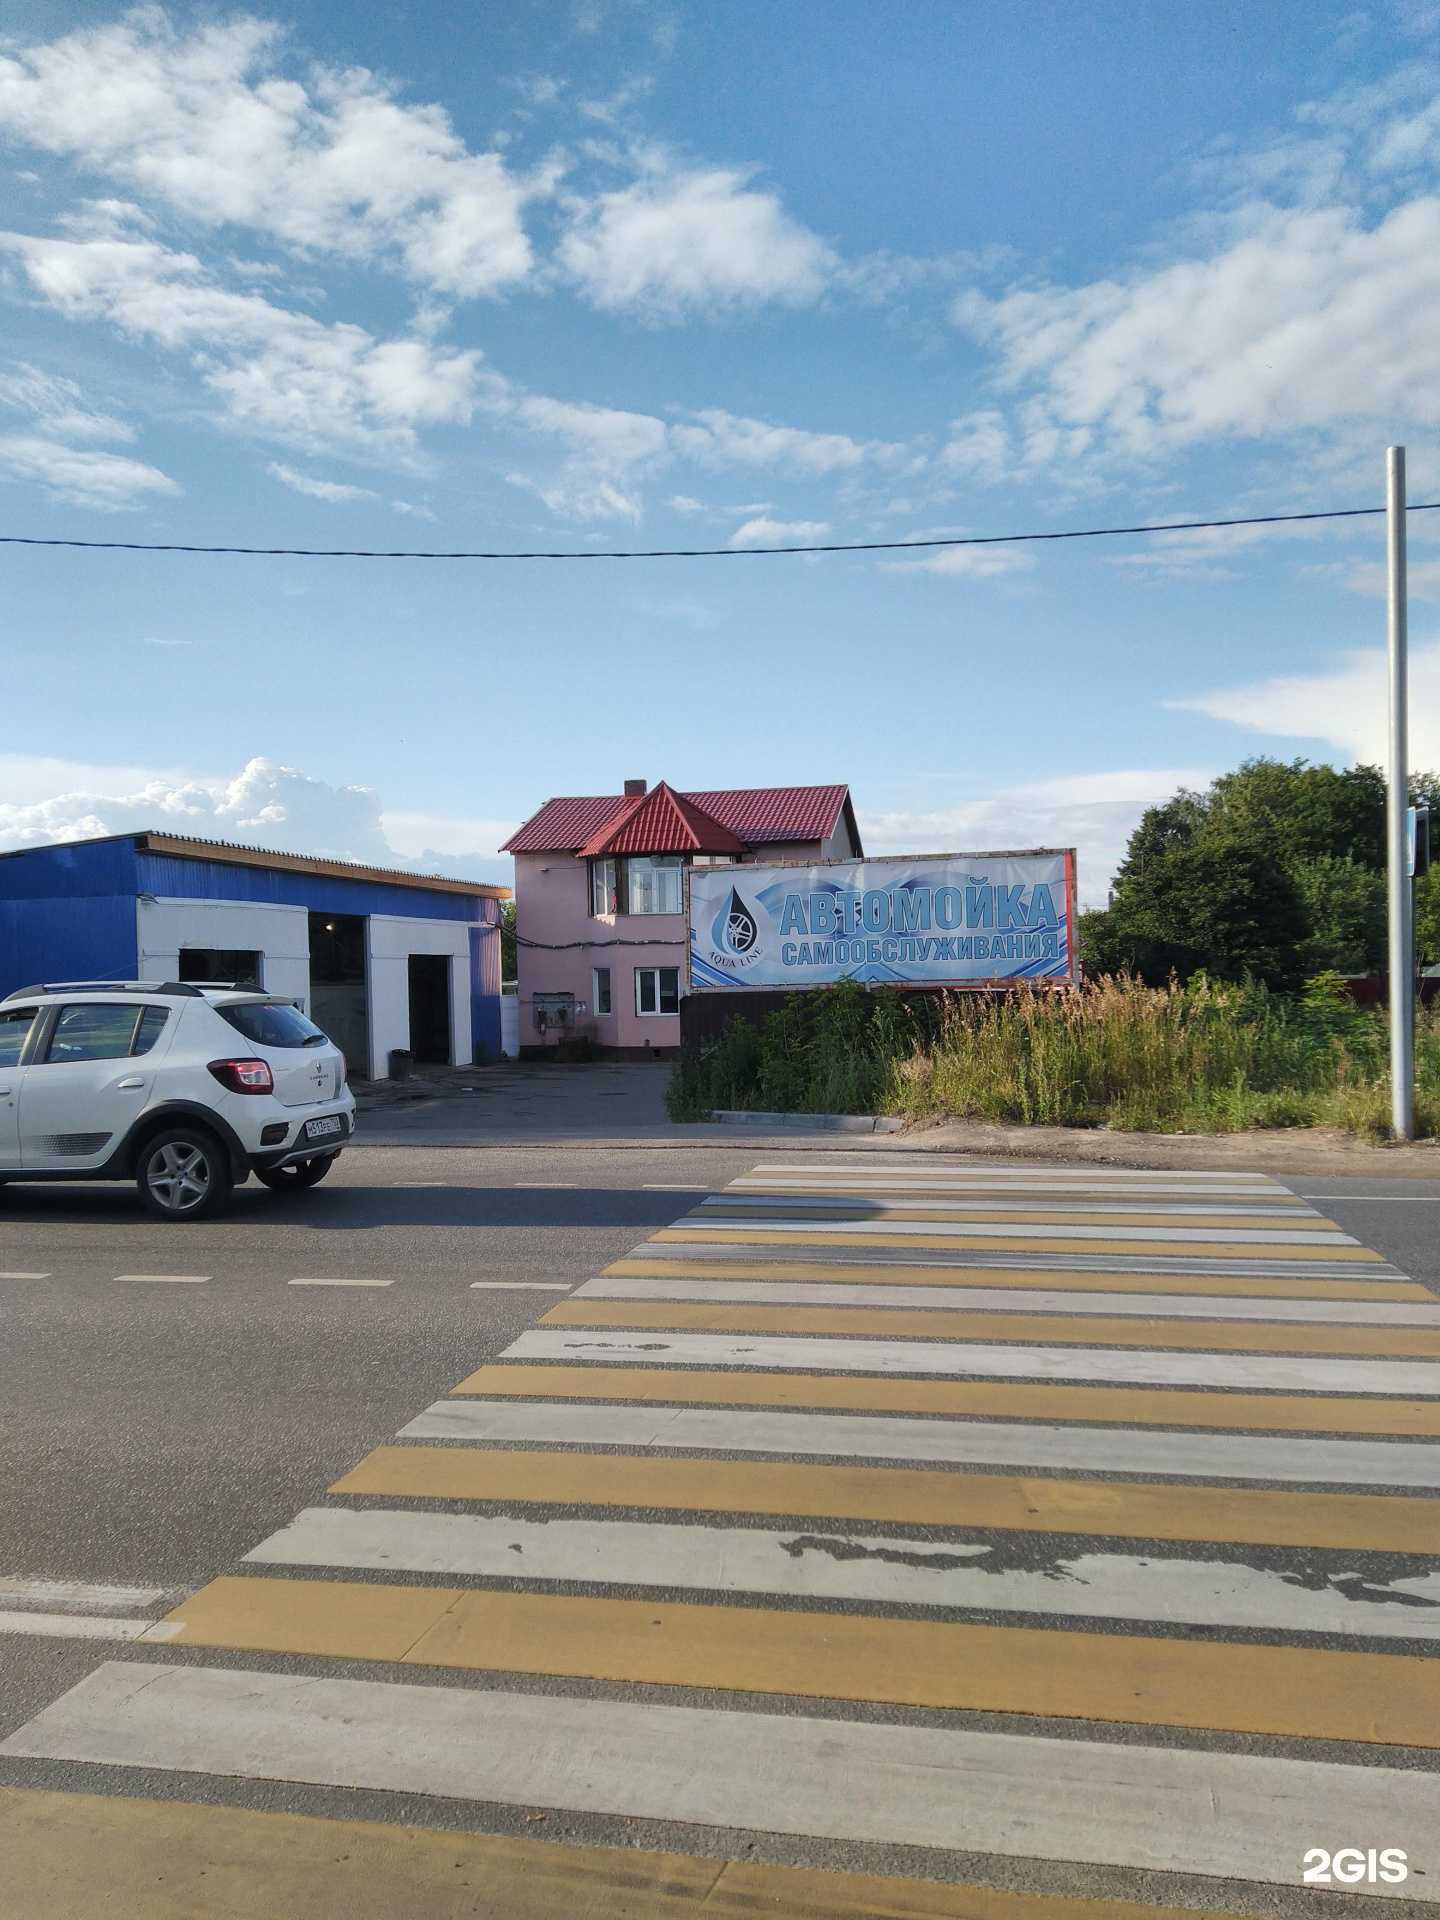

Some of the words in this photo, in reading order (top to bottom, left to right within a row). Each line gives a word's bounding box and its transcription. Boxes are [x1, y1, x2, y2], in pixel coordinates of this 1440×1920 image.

[780, 876, 1059, 936] АВТОМОЙКА
[709, 951, 736, 968] AQUA
[739, 946, 762, 967] LINE
[781, 933, 1060, 966] САМООБСЛУЖИВАНИЯ
